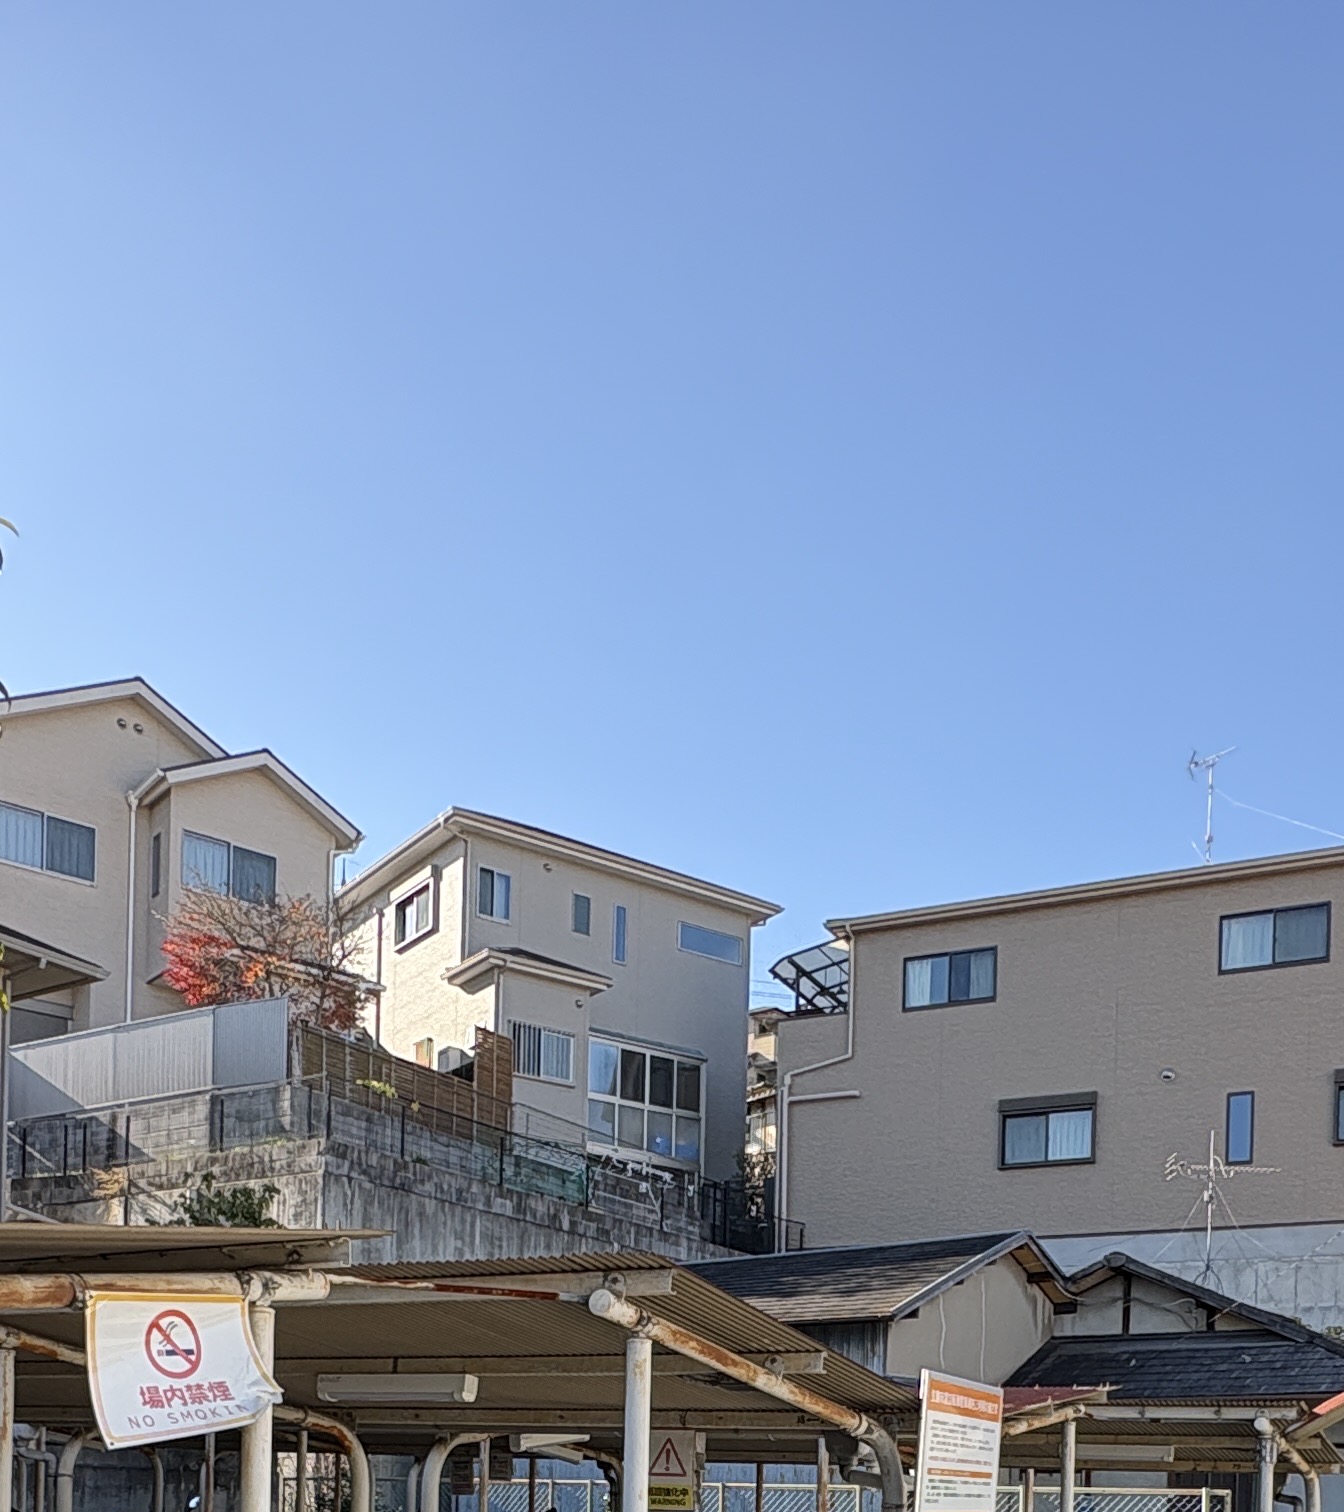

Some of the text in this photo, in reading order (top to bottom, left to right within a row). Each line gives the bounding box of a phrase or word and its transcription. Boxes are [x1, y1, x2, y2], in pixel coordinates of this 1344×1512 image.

[139, 1381, 236, 1410] 場内禁煙
[127, 1415, 156, 1430] NO
